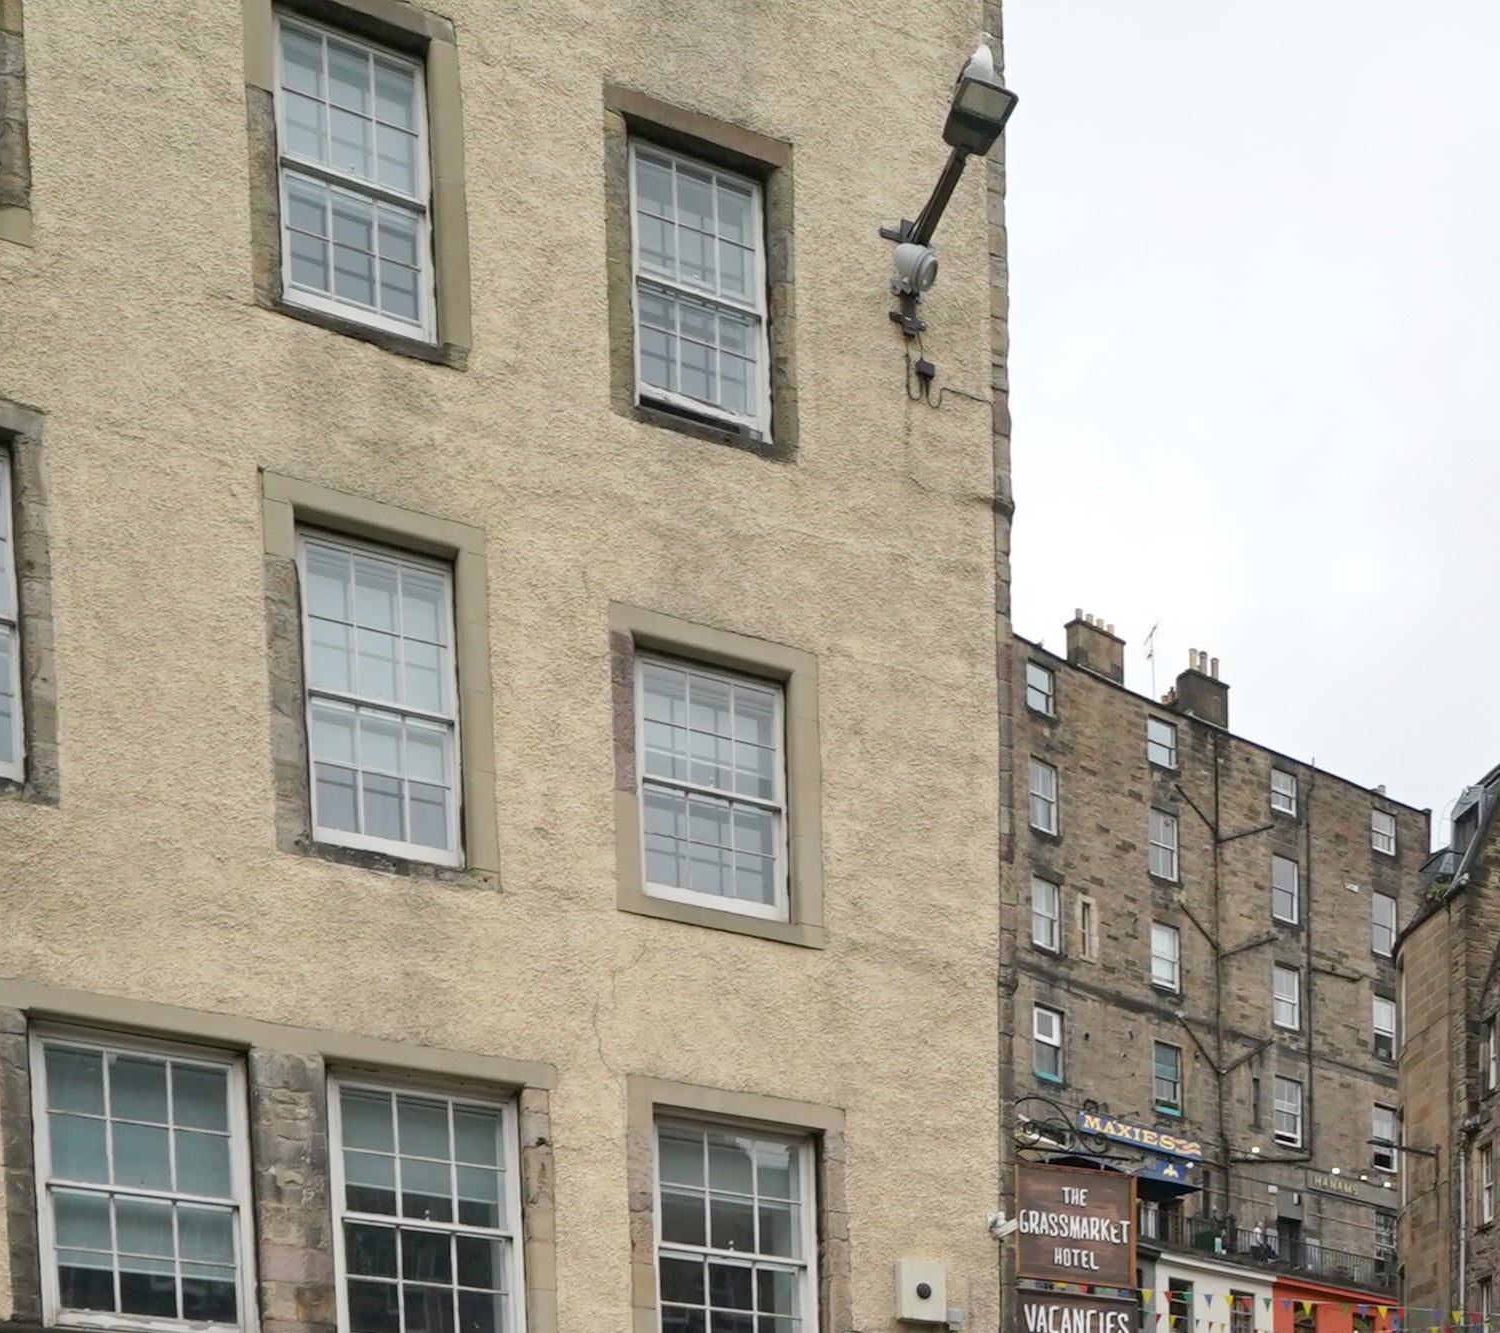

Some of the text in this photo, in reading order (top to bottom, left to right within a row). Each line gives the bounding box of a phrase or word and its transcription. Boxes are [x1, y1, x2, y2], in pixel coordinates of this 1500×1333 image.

[1083, 1113, 1176, 1153] MAXIES
[1061, 1186, 1088, 1207] THE
[1314, 1175, 1359, 1196] HANAMS
[1019, 1208, 1131, 1244] GRASSMARKET
[1053, 1246, 1100, 1272] HOTEL
